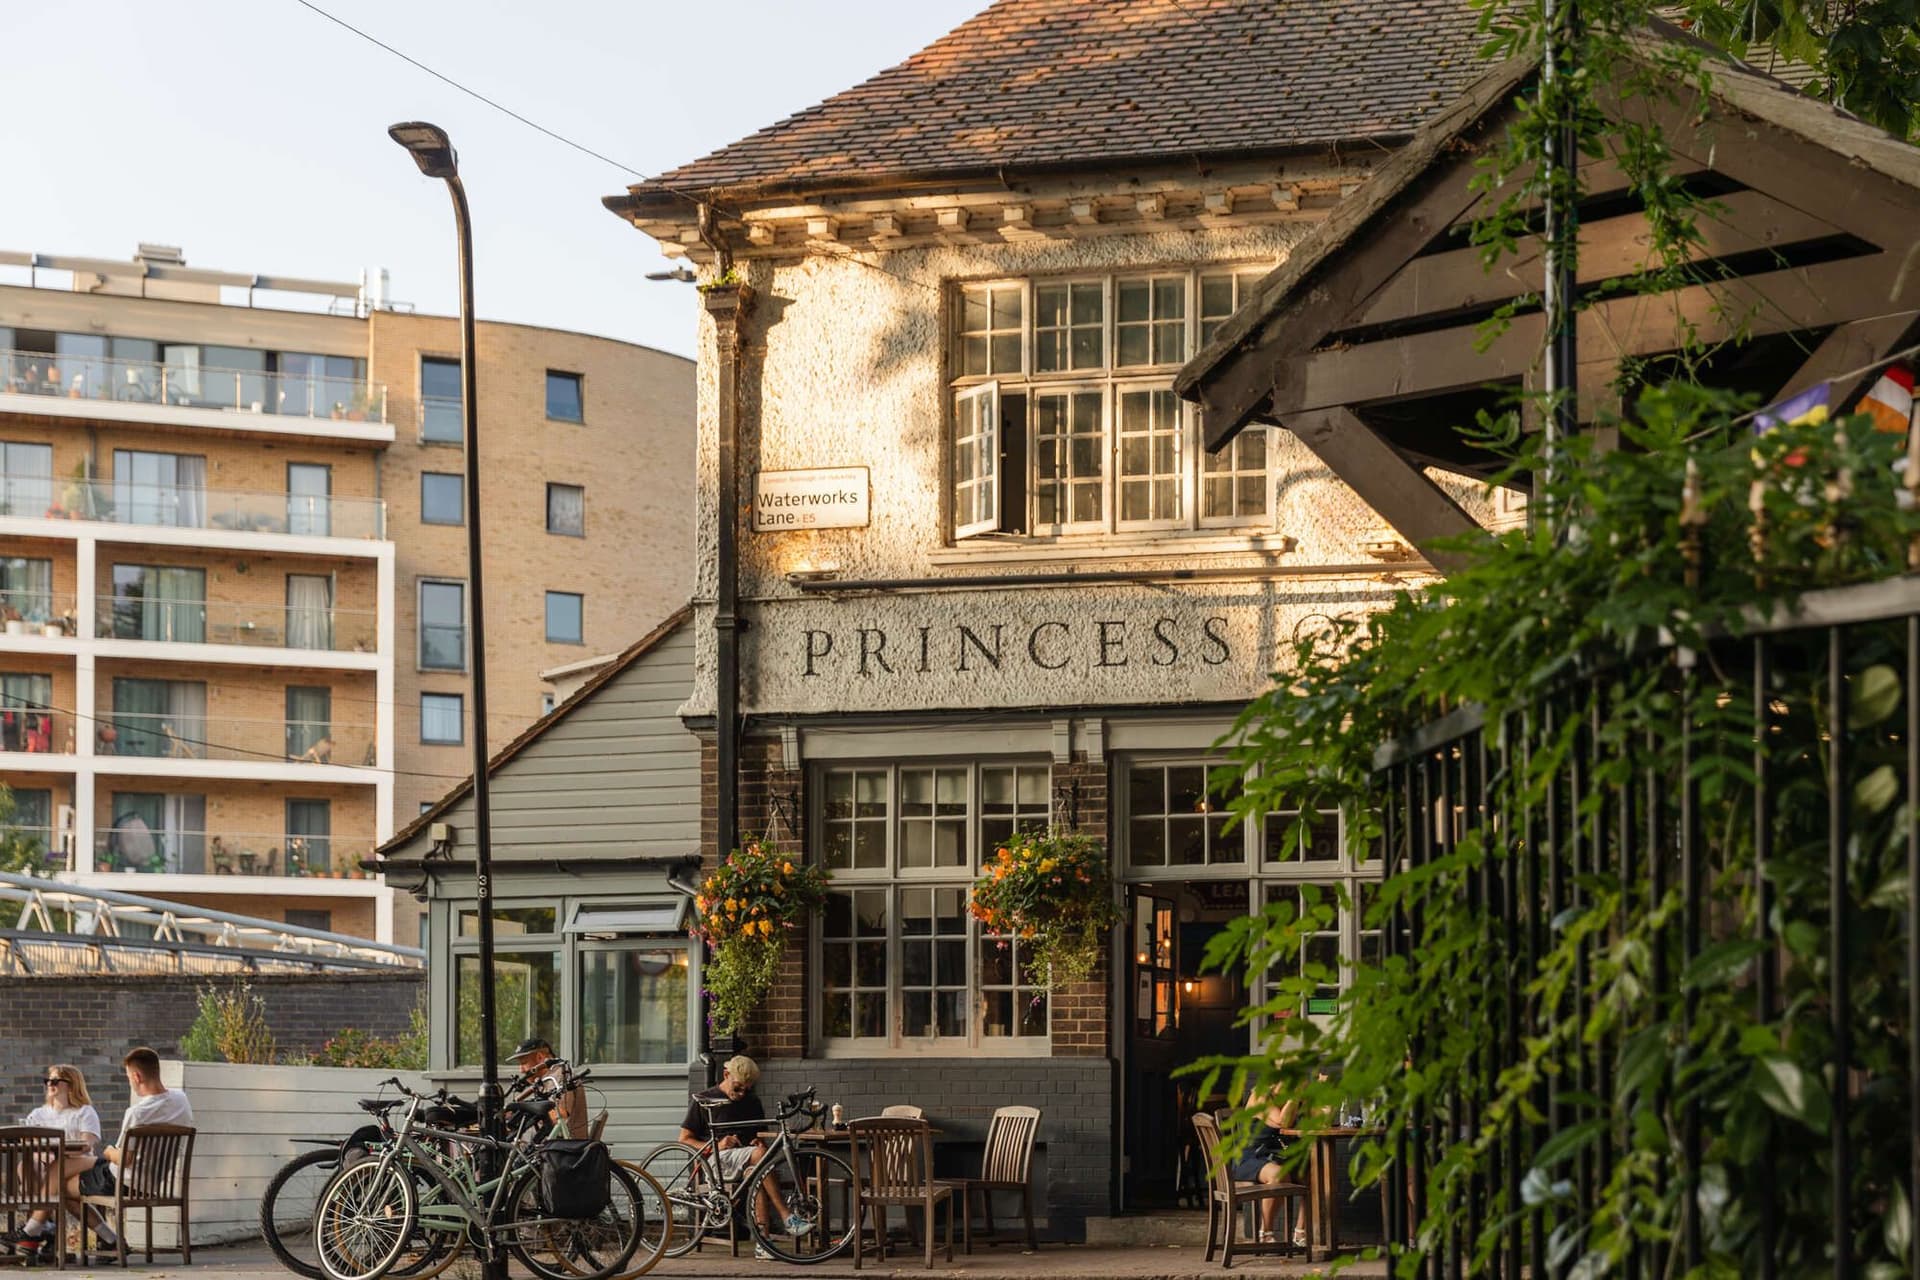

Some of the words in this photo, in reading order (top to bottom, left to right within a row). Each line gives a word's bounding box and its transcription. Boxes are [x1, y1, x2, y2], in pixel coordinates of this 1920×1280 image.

[758, 490, 858, 507] Waterworks
[758, 510, 795, 525] Lane
[801, 616, 1230, 677] PRINCESS
[479, 875, 488, 898] 39
